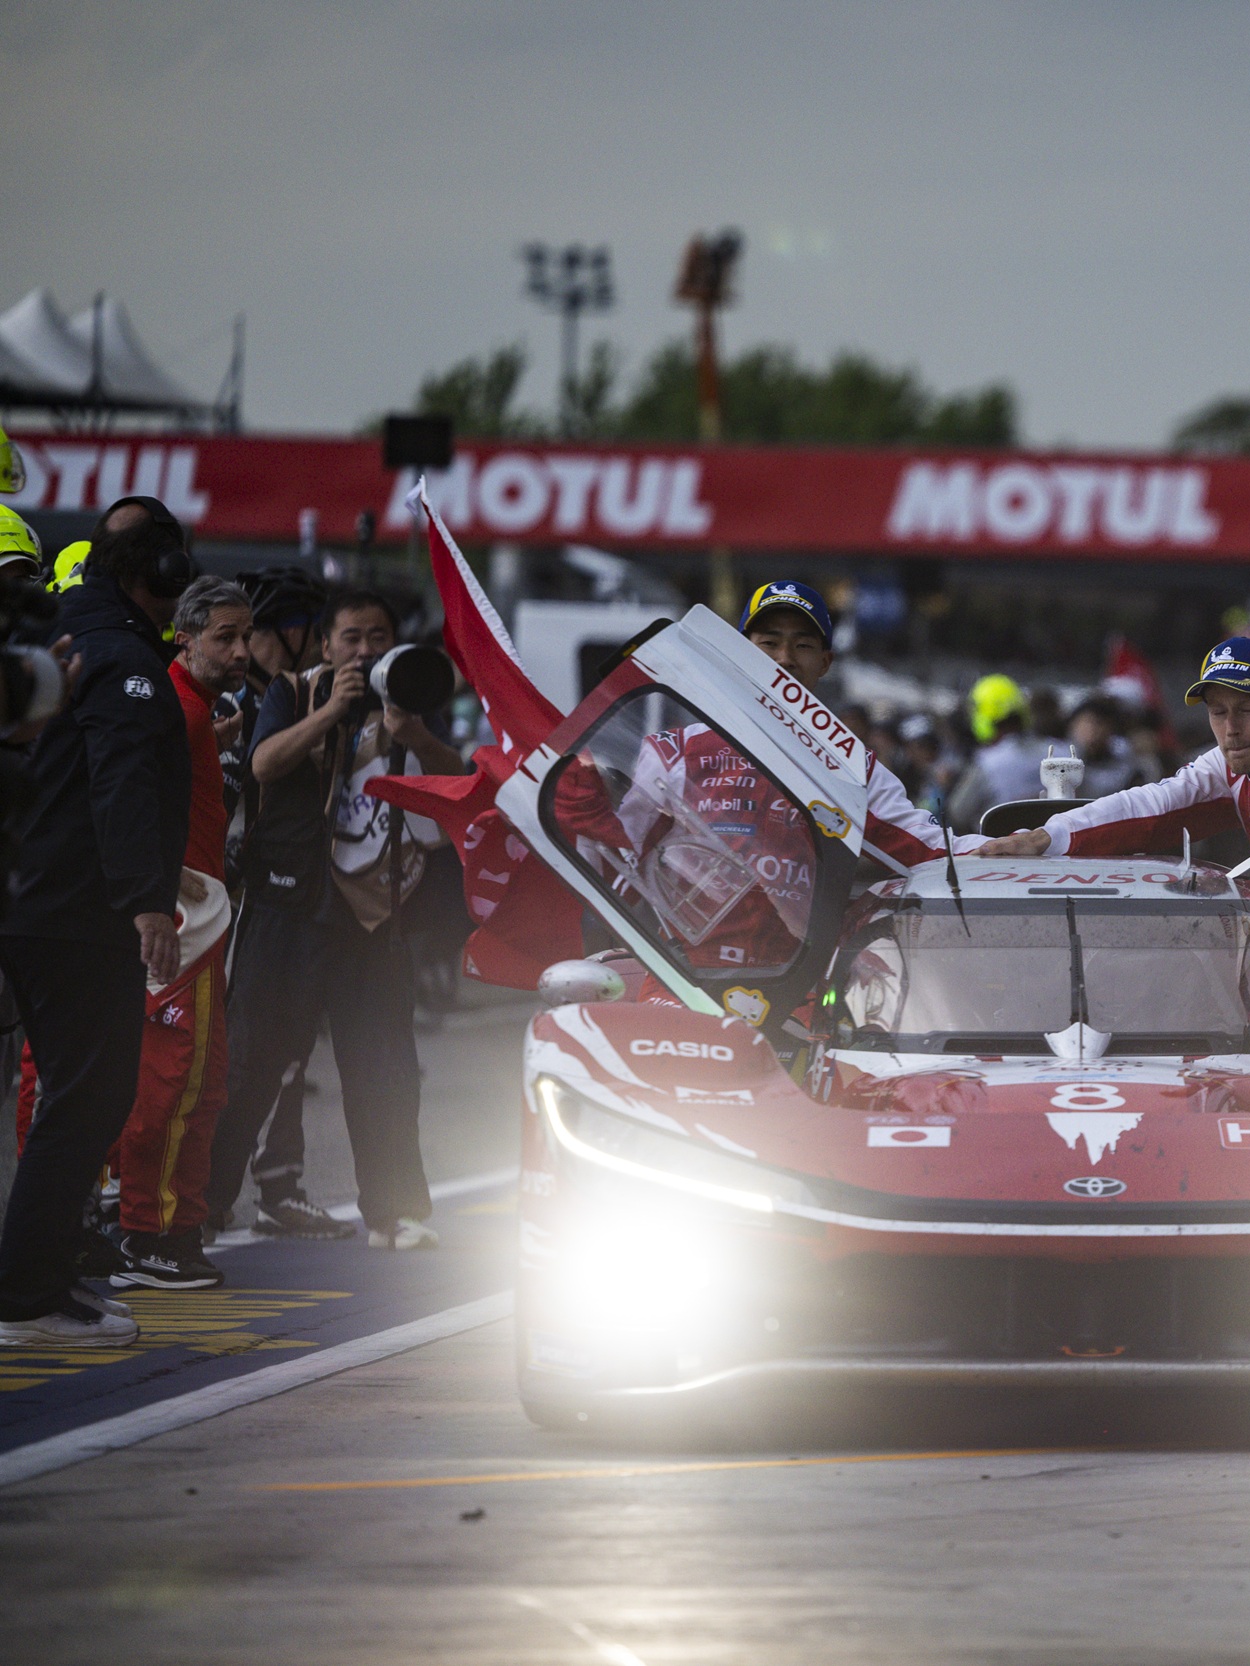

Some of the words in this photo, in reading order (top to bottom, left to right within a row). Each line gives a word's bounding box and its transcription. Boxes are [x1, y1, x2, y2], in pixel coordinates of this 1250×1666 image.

[386, 452, 716, 535] MOTUL
[888, 463, 1219, 544] MOTUL
[771, 668, 856, 759] TOYOTA
[698, 799, 740, 811] Mobil
[967, 872, 1179, 884] DENSO
[630, 1039, 734, 1062] CASIO
[1050, 1083, 1126, 1110] 8
